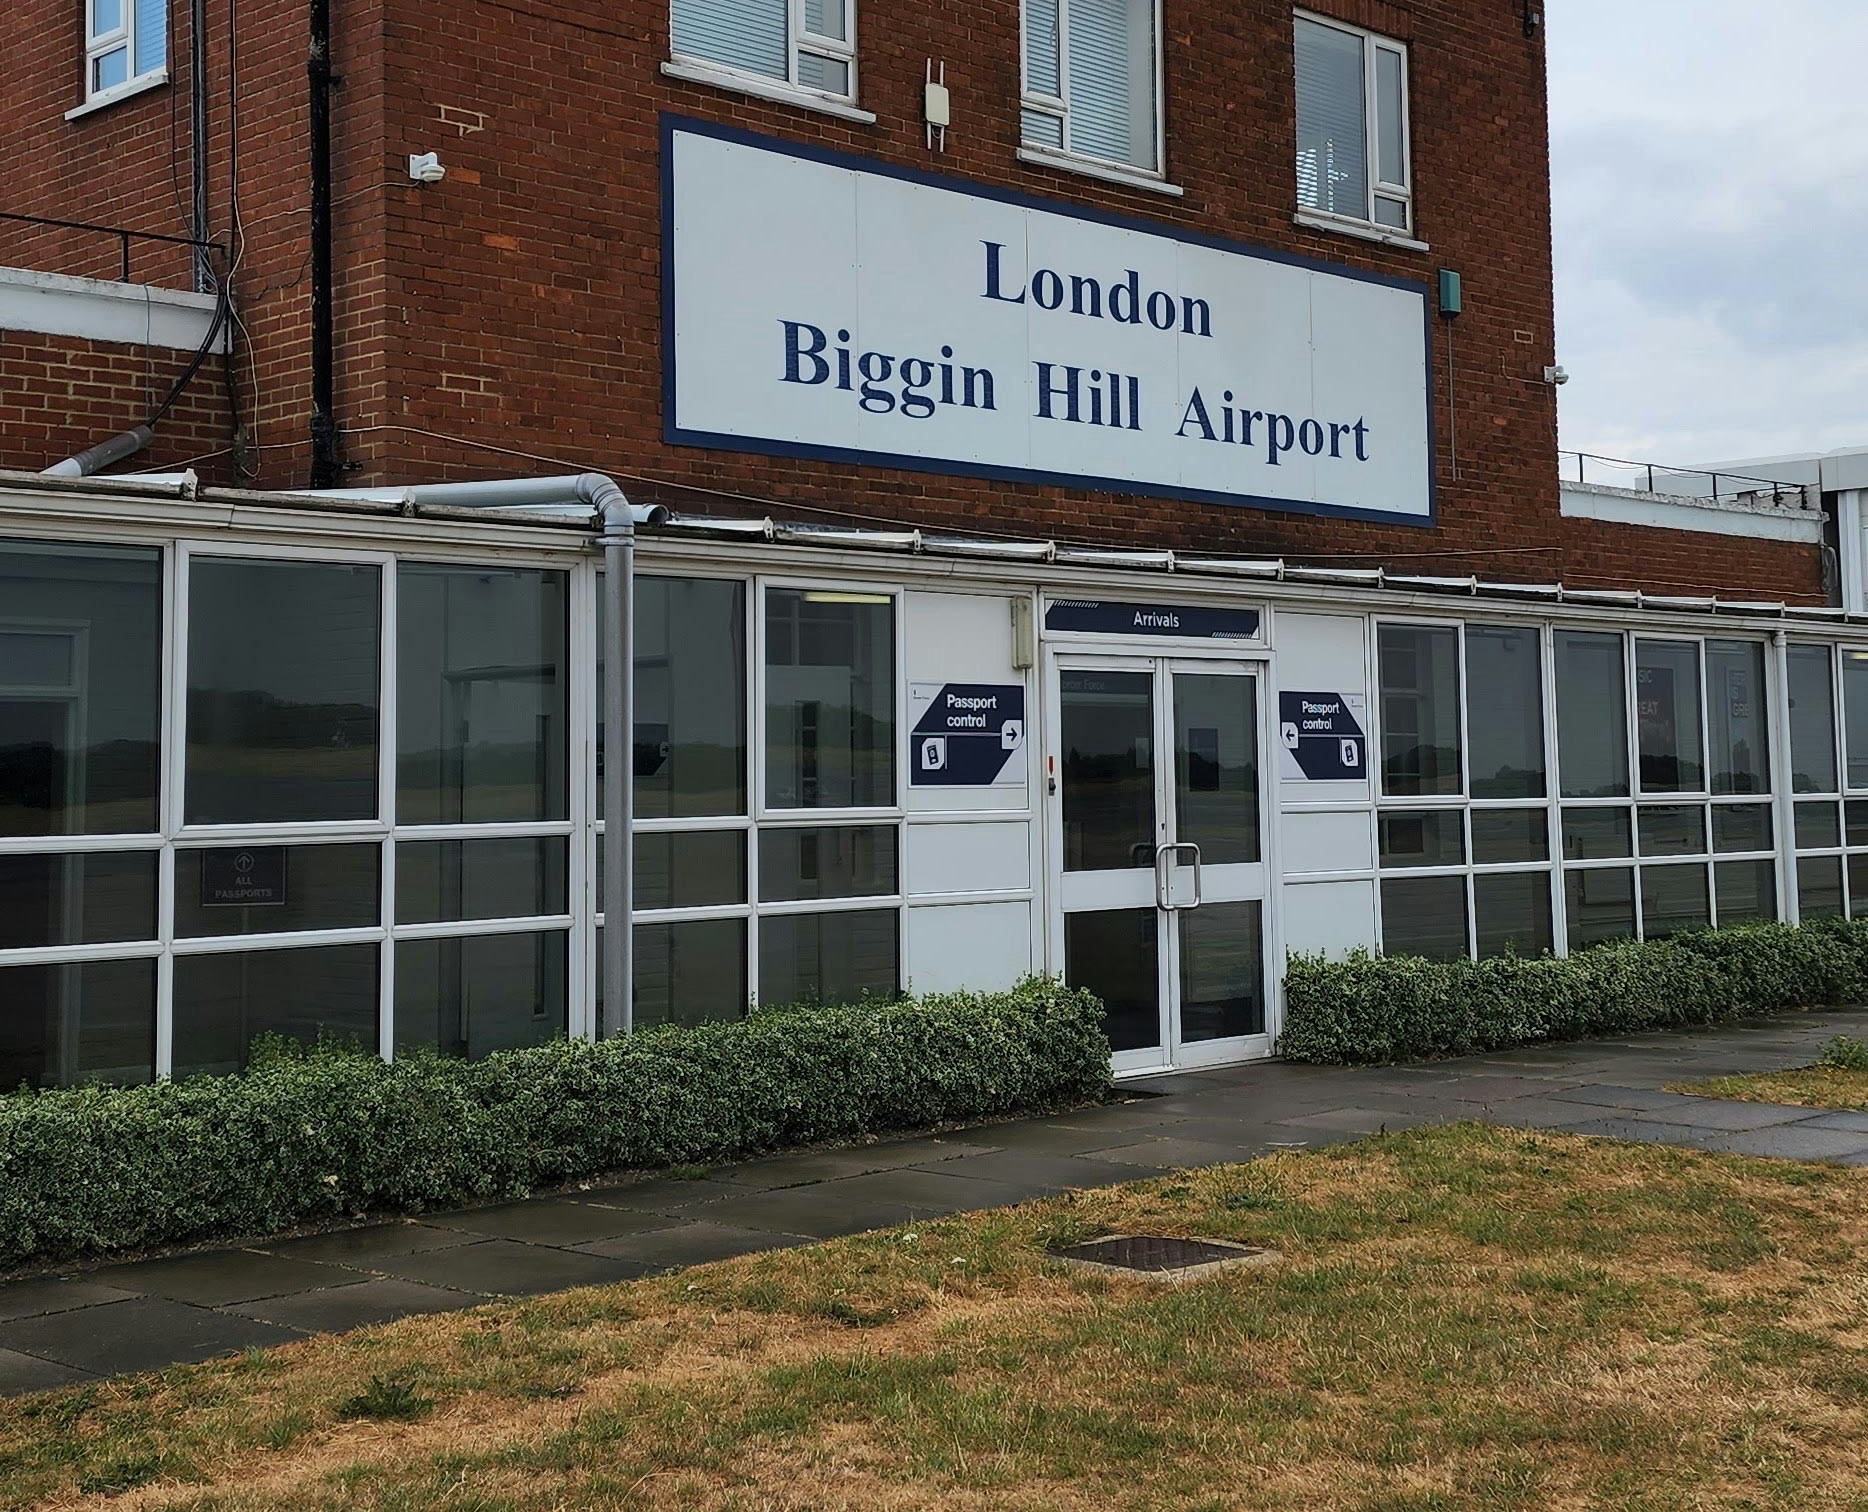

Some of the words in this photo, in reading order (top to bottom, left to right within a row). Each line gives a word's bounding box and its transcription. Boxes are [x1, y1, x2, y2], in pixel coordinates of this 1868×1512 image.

[979, 239, 1214, 338] London
[777, 319, 998, 419] Biggin
[1032, 361, 1143, 431] Hill
[1174, 385, 1370, 467] Airport
[1133, 610, 1180, 629] Arrivals
[946, 693, 997, 712] Passport
[1302, 700, 1340, 716] Passport
[946, 713, 987, 728] control
[1302, 718, 1332, 730] control
[235, 877, 253, 886] ALL
[215, 888, 272, 898] PASSPORTS
